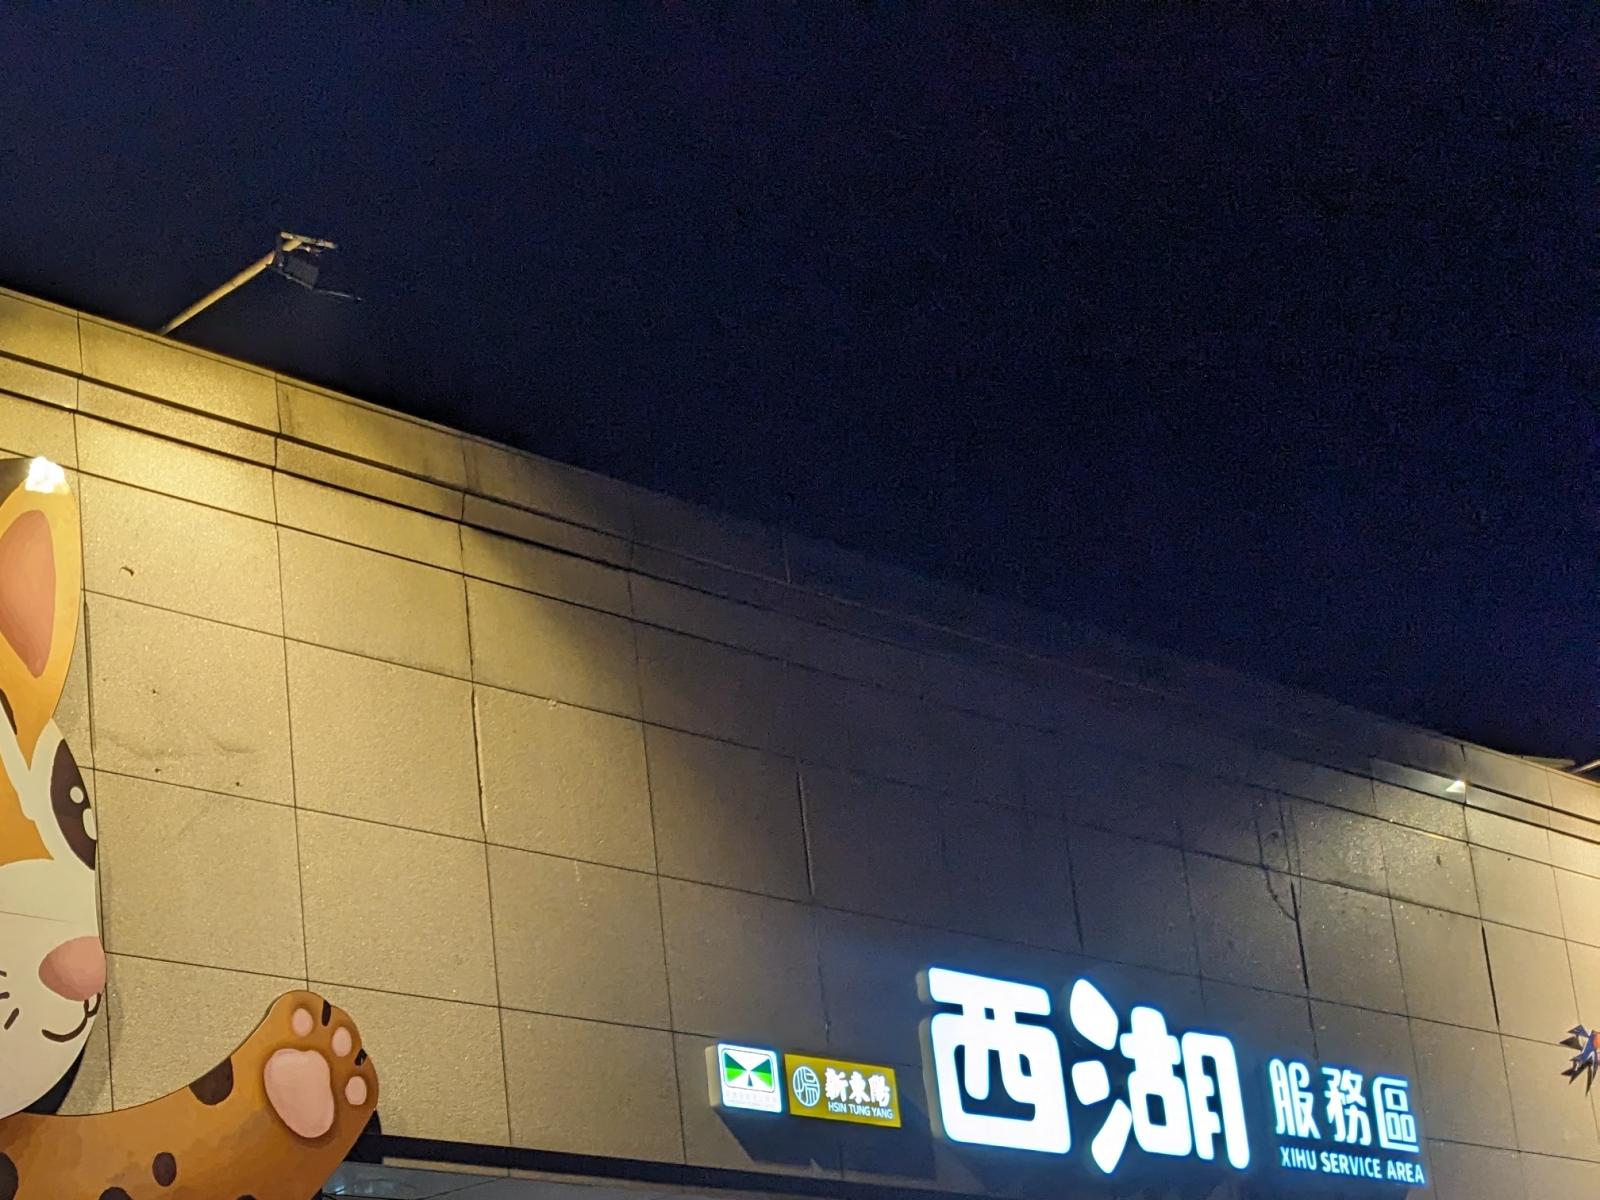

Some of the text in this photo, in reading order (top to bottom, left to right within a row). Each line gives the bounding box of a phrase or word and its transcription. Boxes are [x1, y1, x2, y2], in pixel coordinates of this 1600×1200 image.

[824, 1067, 891, 1107] 新東陽
[926, 966, 1420, 1174] 西湖 服務區
[828, 1101, 893, 1119] HSIN TUNG YANG
[1280, 1146, 1425, 1185] XIHU SERVICE AREA
